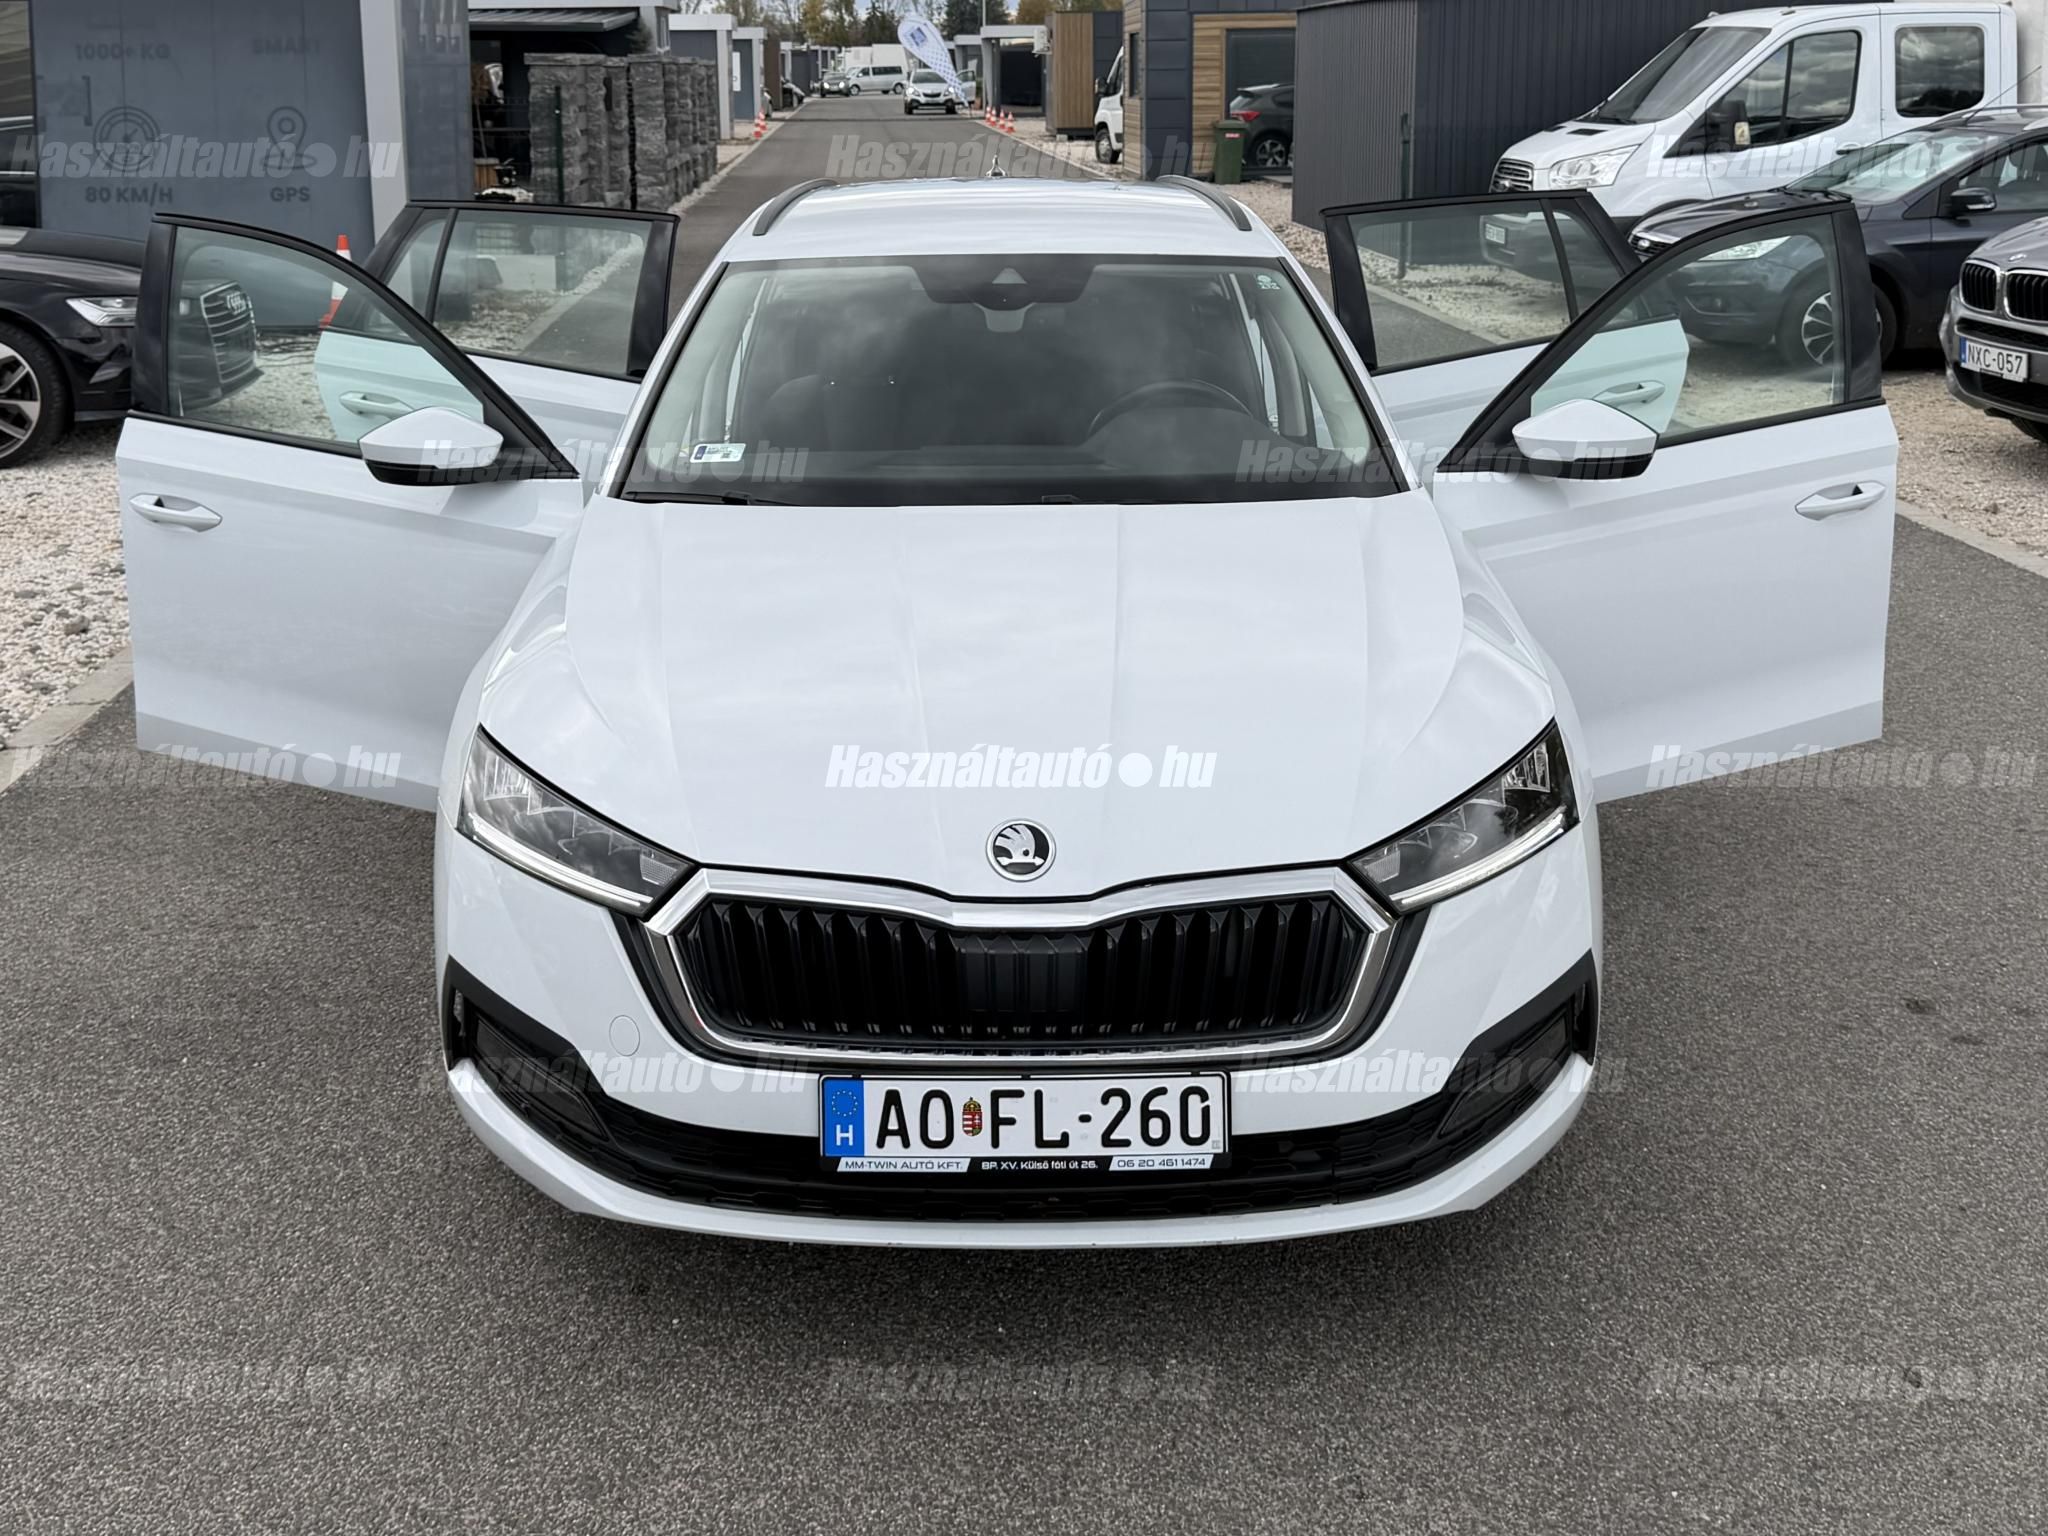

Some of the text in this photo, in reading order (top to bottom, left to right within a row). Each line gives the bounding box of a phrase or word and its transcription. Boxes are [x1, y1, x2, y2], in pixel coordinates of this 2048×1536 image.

[85, 184, 173, 203] 80 KM/H
[270, 187, 310, 202] GPS
[1968, 343, 2023, 374] NXC-057
[876, 1089, 954, 1149] AO
[836, 1124, 853, 1146] H
[845, 1161, 897, 1170] MM-TWIN
[938, 1161, 963, 1170] KFT.
[982, 1162, 998, 1170] BP.
[1000, 1161, 1019, 1170] XV.
[1081, 1160, 1098, 1169] 26.
[1117, 1157, 1206, 1168] 06 20 461 1474
